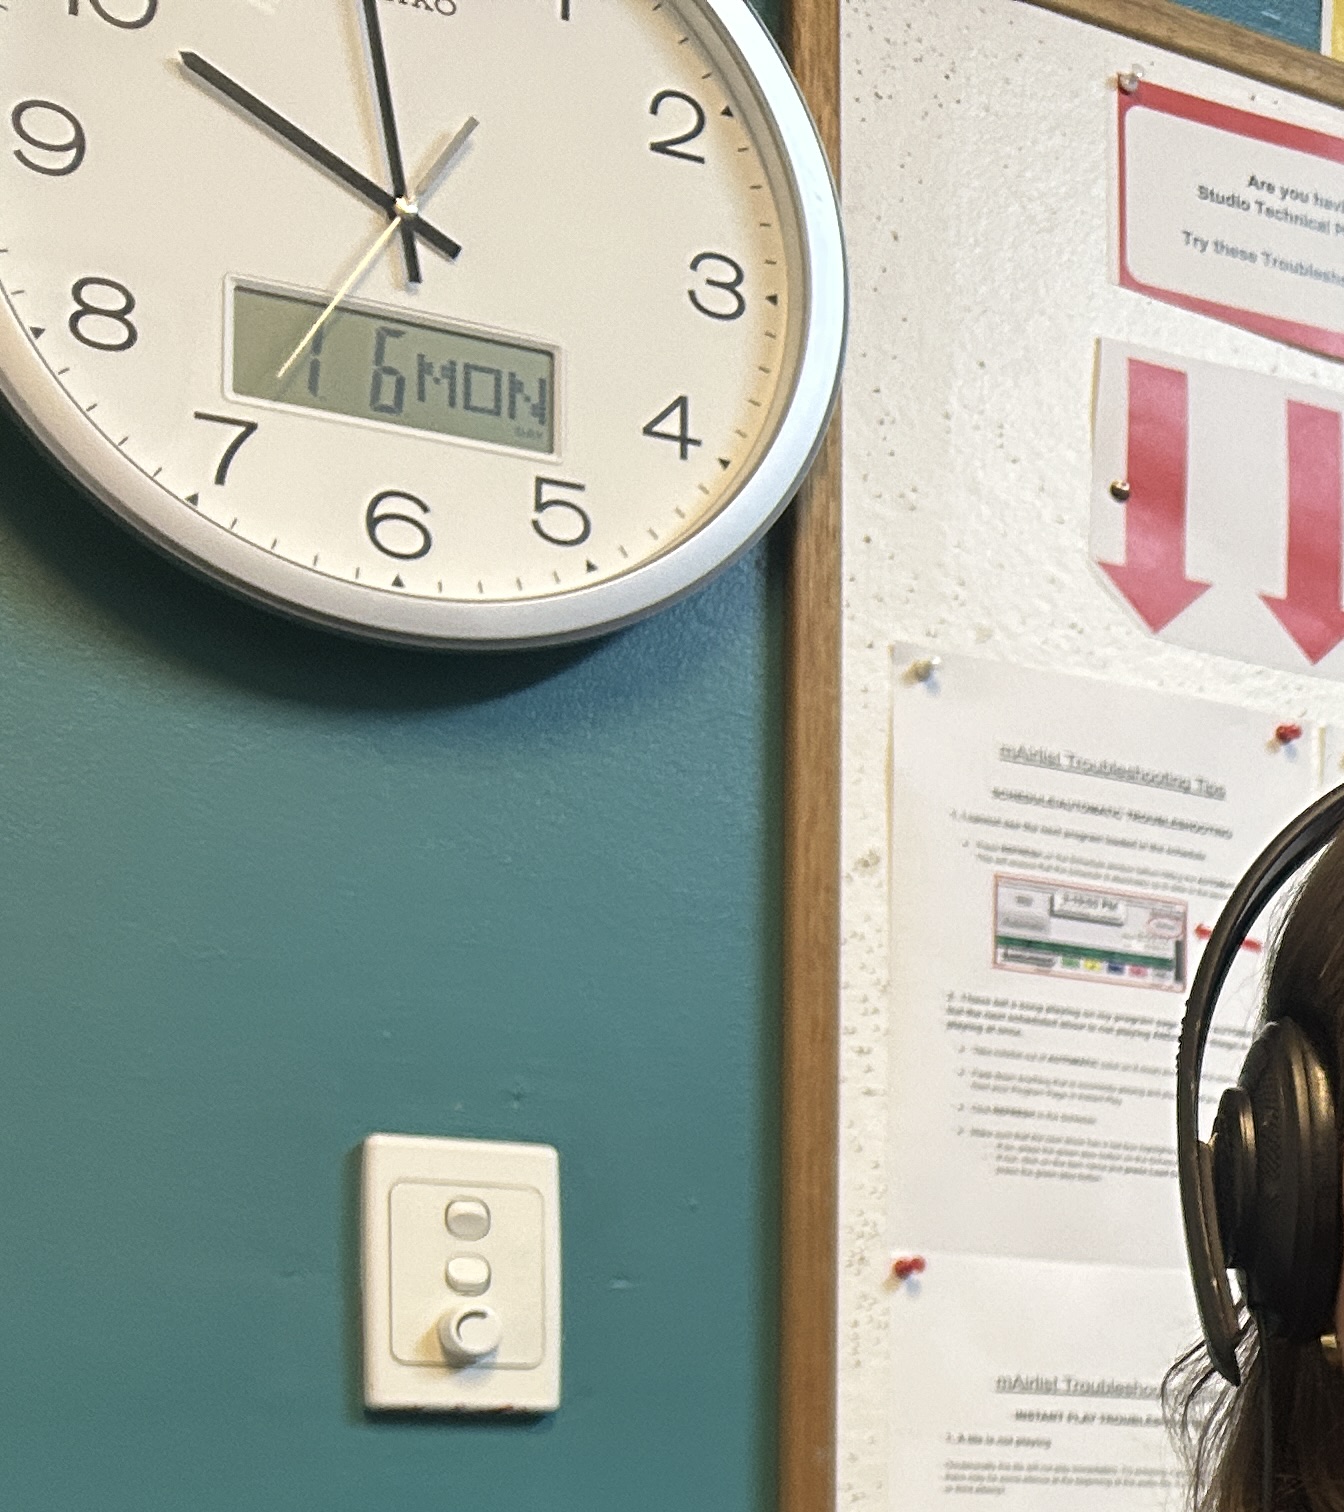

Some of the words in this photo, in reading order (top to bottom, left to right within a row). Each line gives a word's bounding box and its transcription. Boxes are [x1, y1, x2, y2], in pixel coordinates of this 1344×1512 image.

[11, 99, 86, 176] 9
[648, 89, 707, 164] 2
[1197, 184, 1250, 211] Studio
[1255, 199, 1330, 236] Technical
[1247, 174, 1275, 195] Are
[1280, 183, 1309, 206] you
[1182, 230, 1208, 253] Try
[1214, 238, 1257, 264] these
[68, 276, 139, 352] 8
[687, 252, 746, 321] 3
[417, 352, 546, 426] MON
[193, 411, 259, 486] 7
[642, 394, 703, 461] 4
[365, 490, 433, 560] 6
[531, 476, 593, 547] 5
